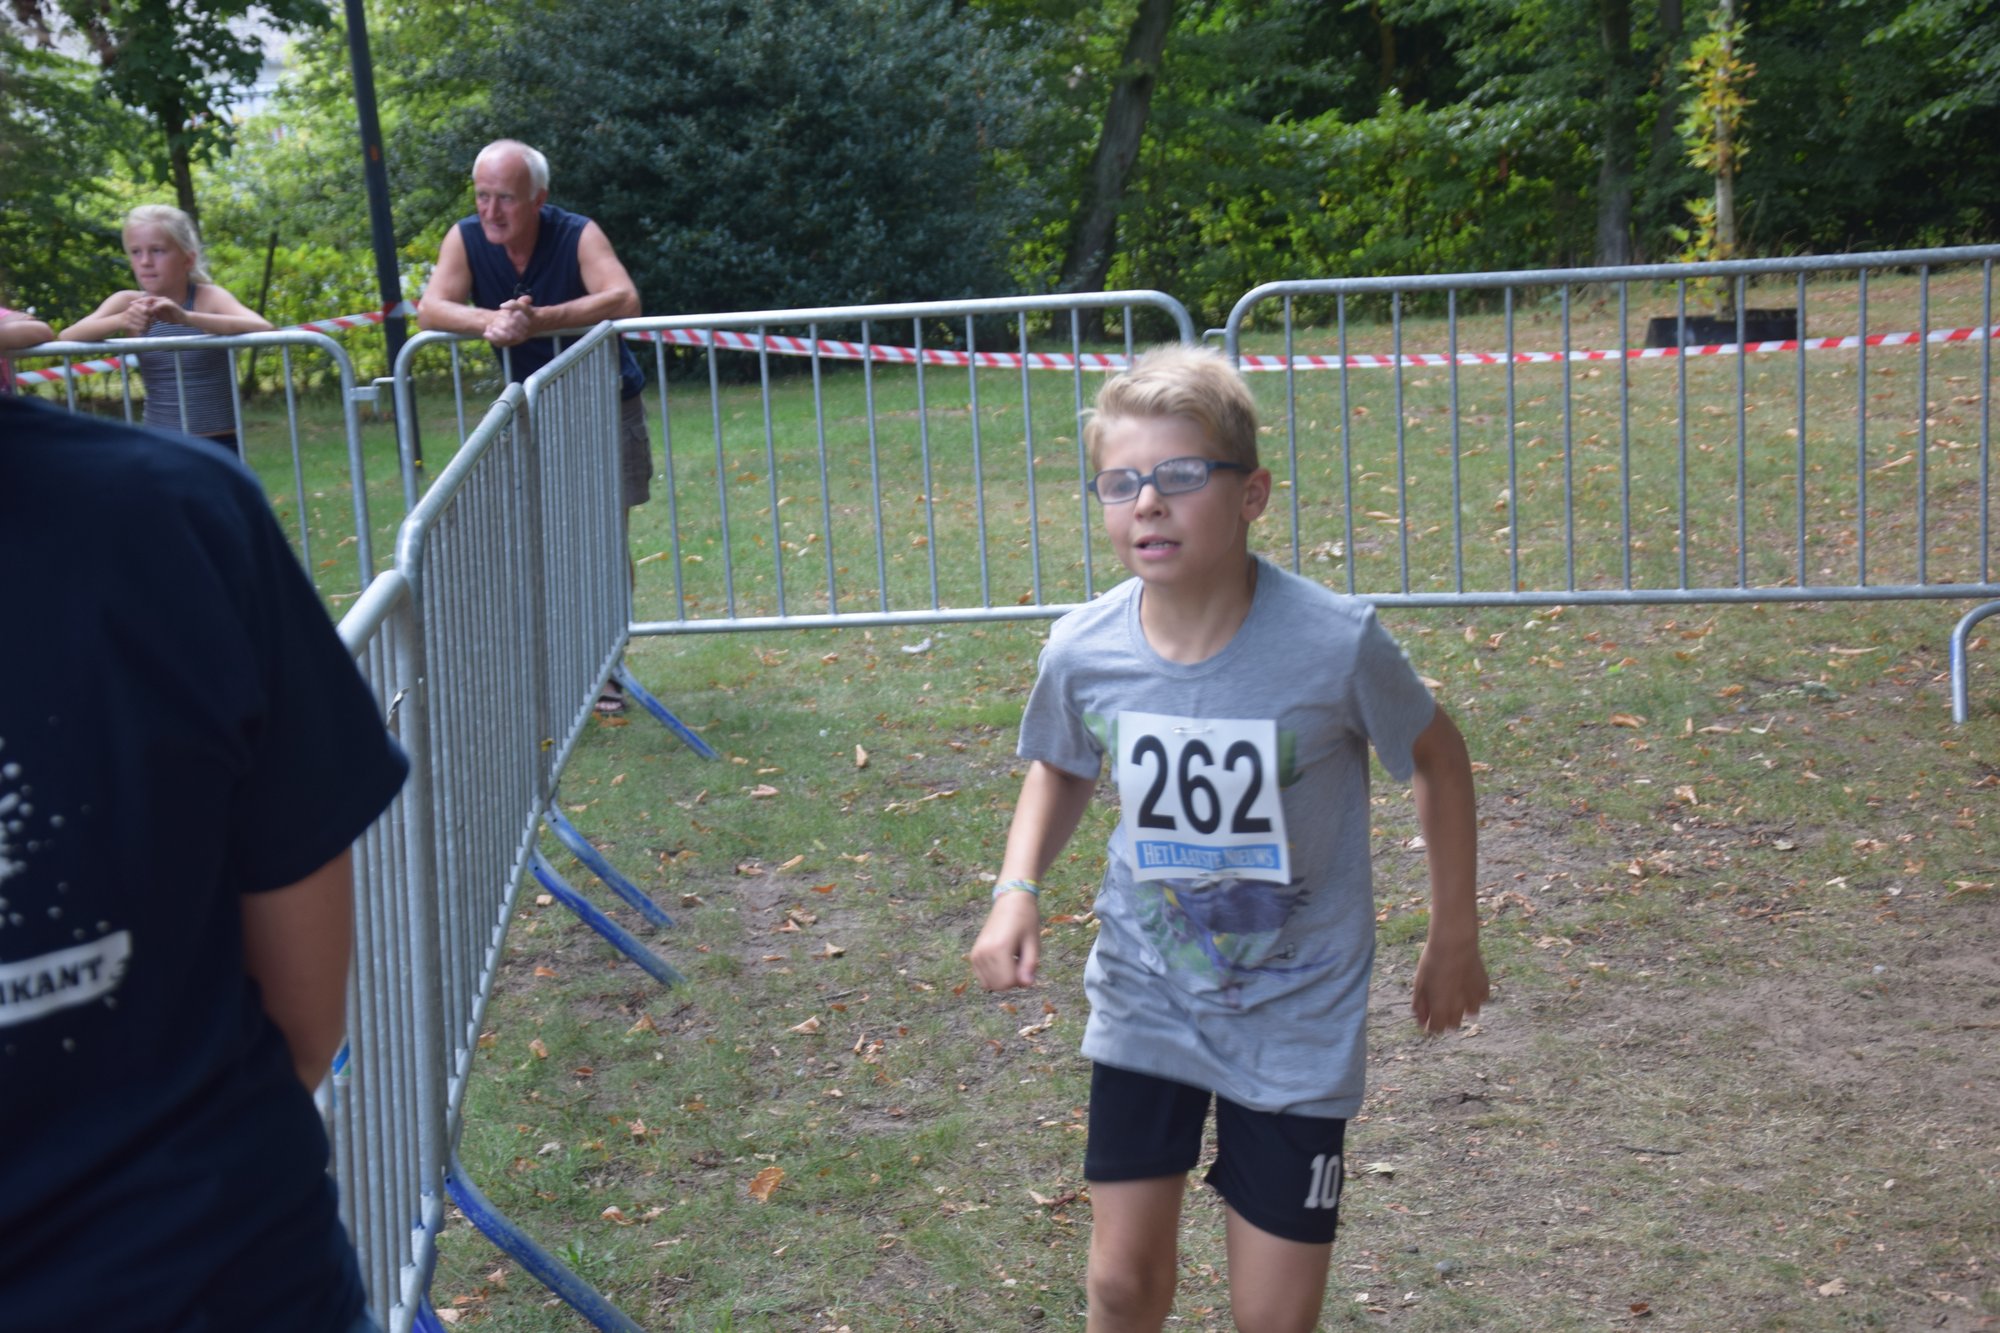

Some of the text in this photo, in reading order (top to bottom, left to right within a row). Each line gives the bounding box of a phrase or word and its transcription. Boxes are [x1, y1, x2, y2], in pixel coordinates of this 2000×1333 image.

[1131, 734, 1273, 835] 262
[1142, 842, 1169, 865] HET
[1223, 847, 1275, 867] NEUS
[1303, 1152, 1341, 1209] 10
